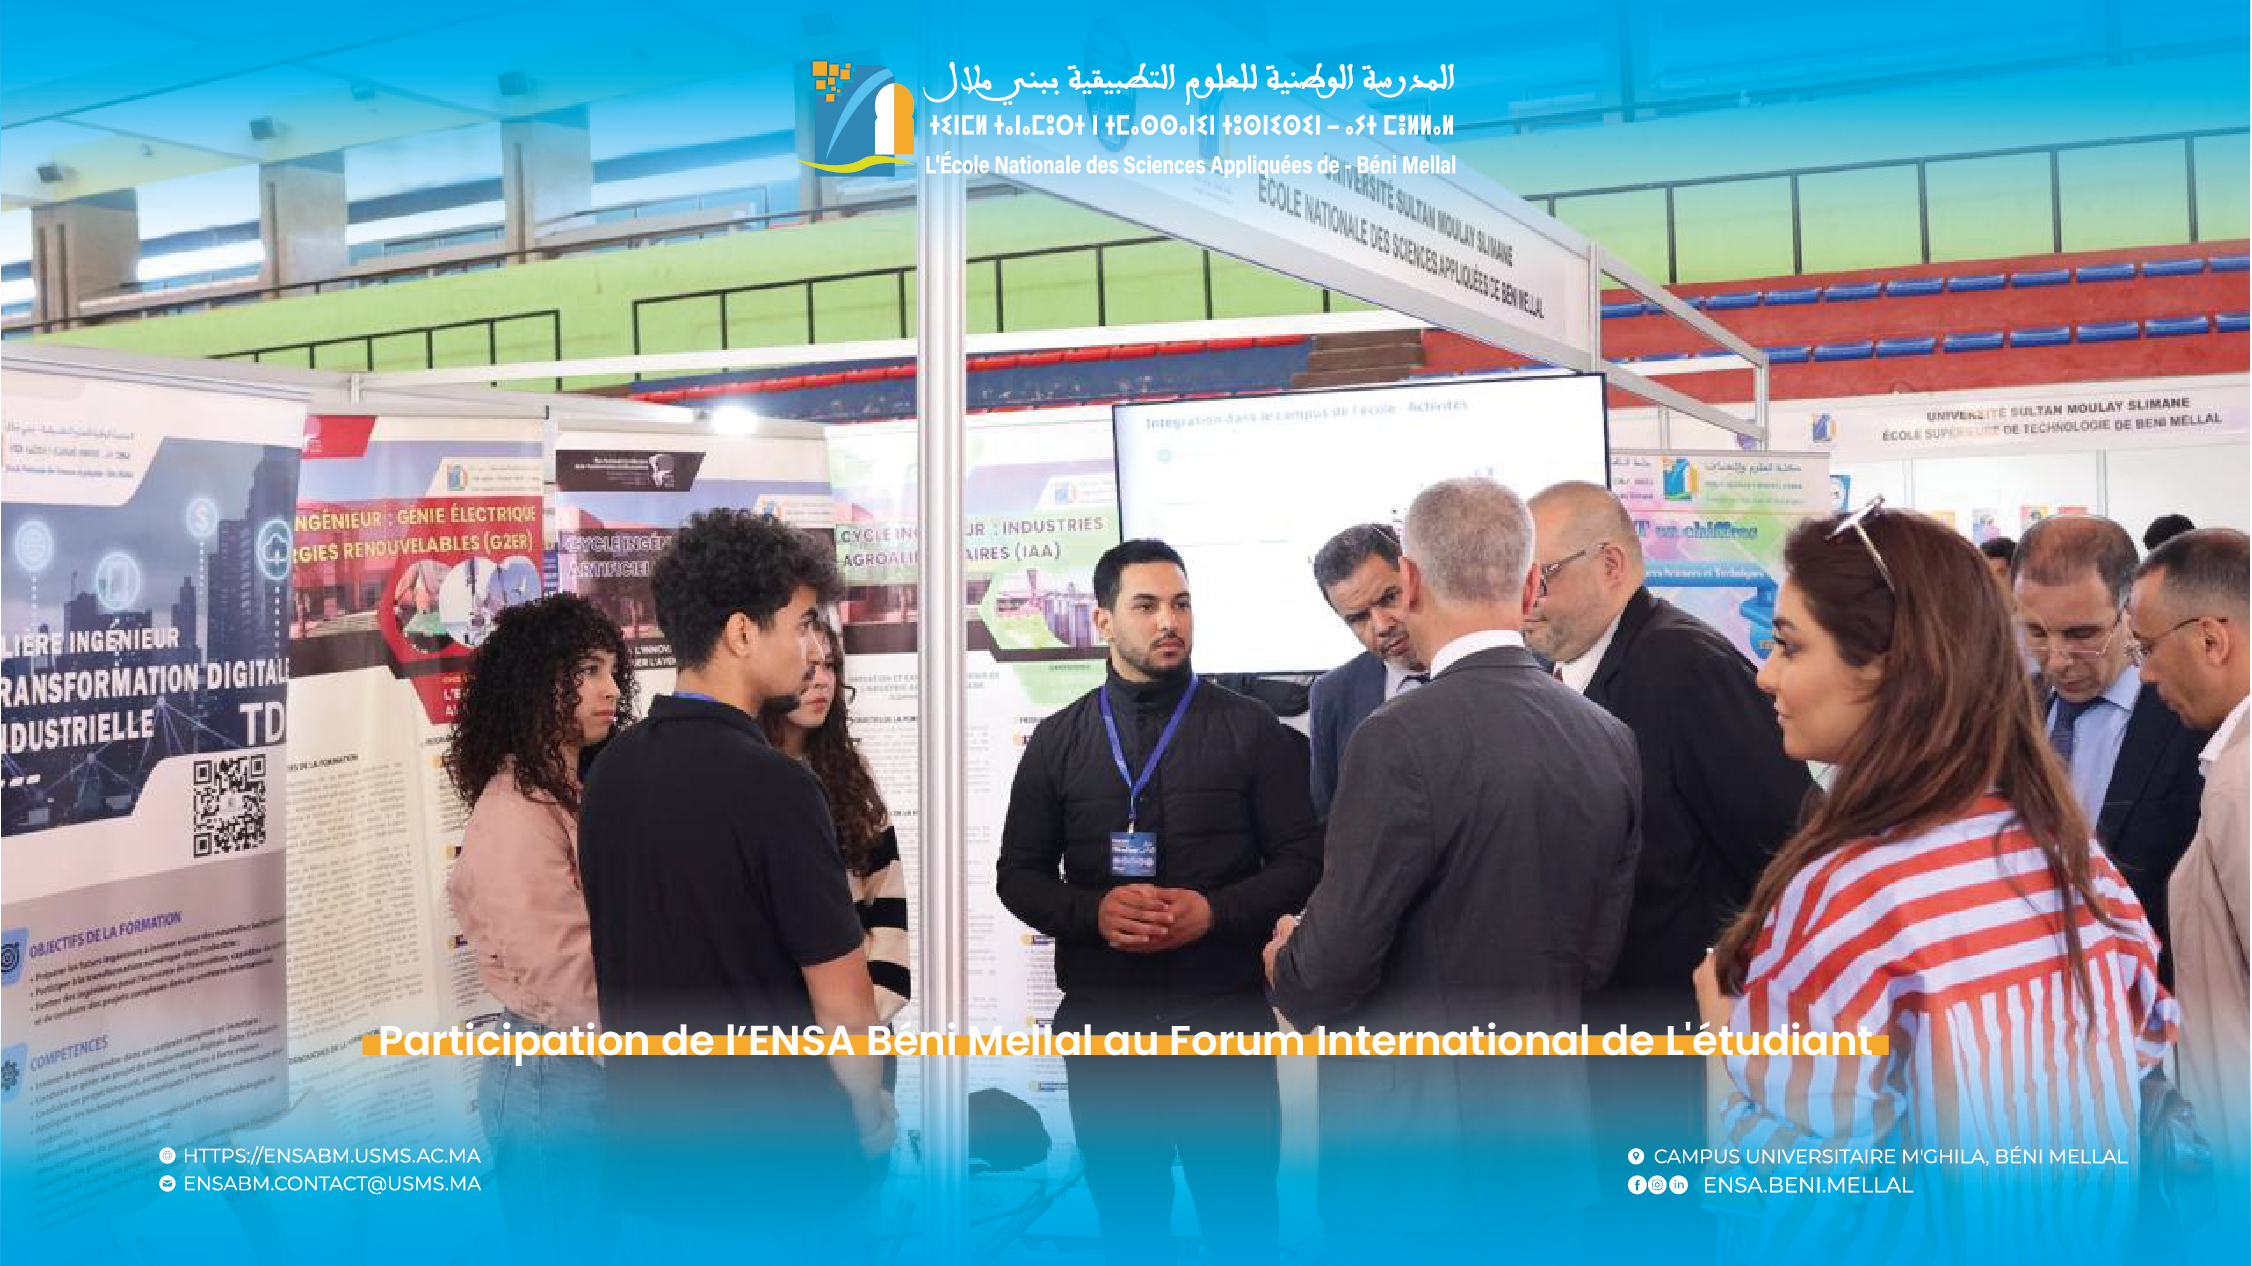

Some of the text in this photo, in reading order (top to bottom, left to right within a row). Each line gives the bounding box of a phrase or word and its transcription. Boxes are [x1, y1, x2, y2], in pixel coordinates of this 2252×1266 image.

[1395, 189, 1435, 232] SULTAN
[1437, 210, 1476, 250] MOULAY
[1304, 194, 1368, 246] NATIONALE
[1369, 224, 1390, 256] DES
[1392, 233, 1438, 276] SCIENCES
[2010, 404, 2063, 418] SULTAN
[2067, 400, 2123, 414] MOULAY
[2128, 397, 2191, 411] SLIMANE
[2003, 423, 2020, 435] DE
[2023, 417, 2111, 434] TECHNOLOGIE
[2114, 417, 2132, 429] DE
[2169, 411, 2223, 427] MELLAL
[1002, 516, 1104, 534] INDUSTRIES
[1014, 541, 1062, 562] (IAA)
[29, 910, 183, 959] OBJECTIFS DE LA FORMATION
